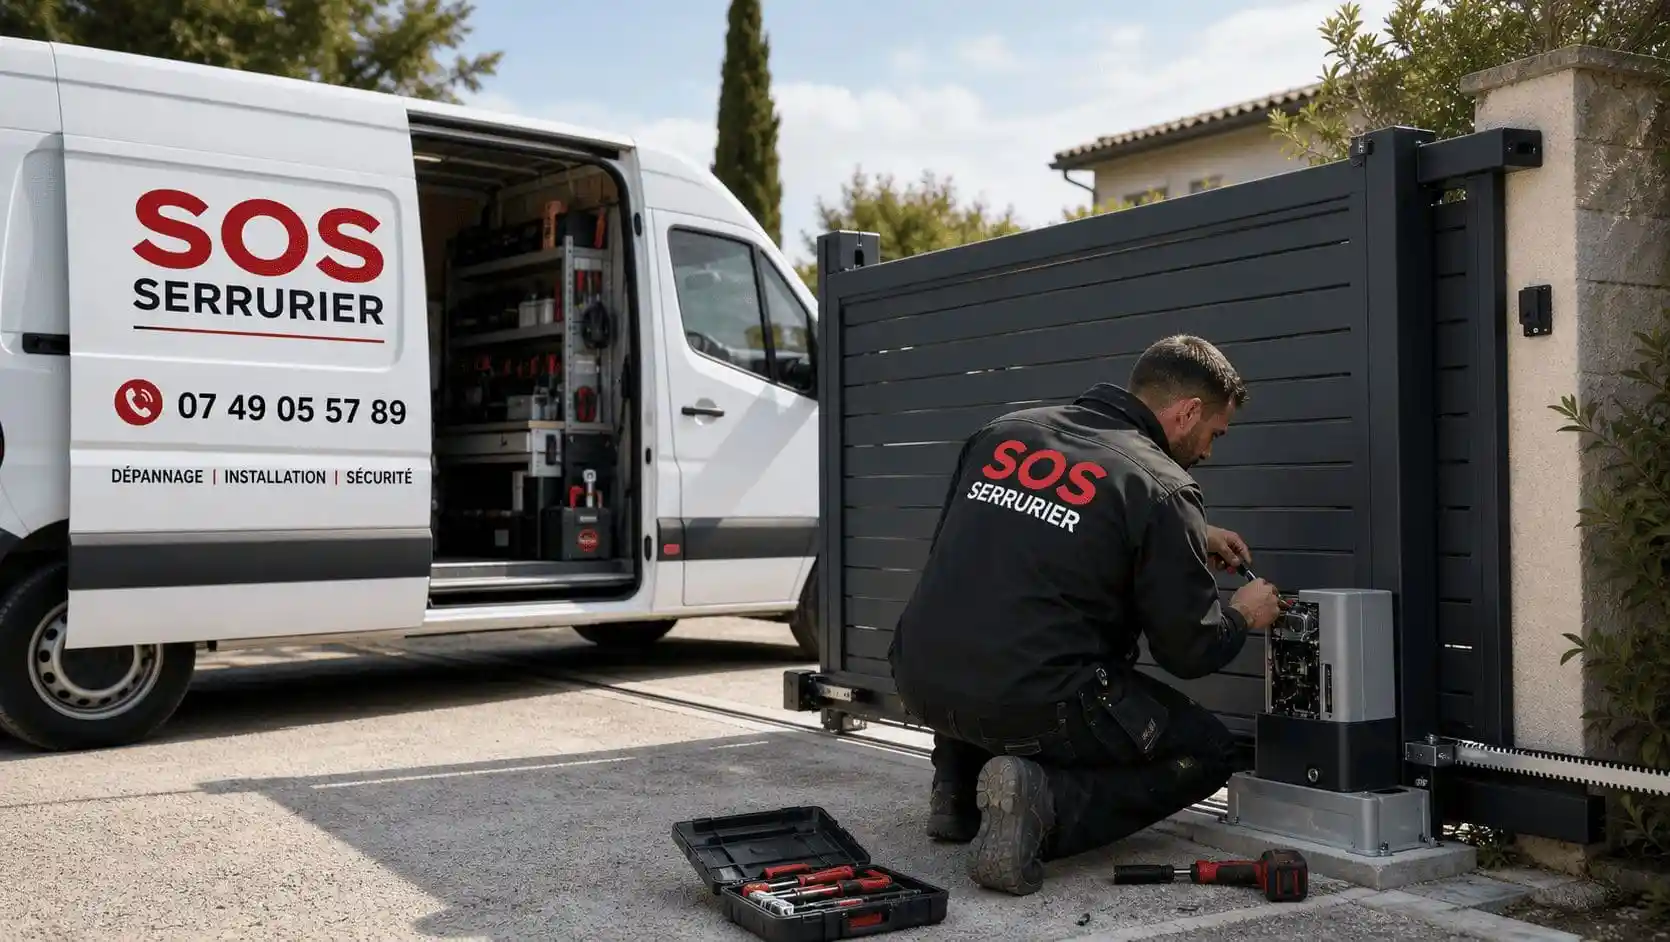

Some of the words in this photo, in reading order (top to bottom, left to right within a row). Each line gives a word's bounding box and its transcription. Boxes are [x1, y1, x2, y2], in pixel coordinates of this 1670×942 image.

[132, 189, 384, 283] SOS
[133, 278, 384, 325] SERRURIER
[178, 392, 217, 419] 07
[227, 395, 266, 421] 49
[277, 396, 315, 422] 05
[325, 398, 361, 424] 57
[370, 399, 407, 425] 89
[111, 466, 204, 484] DÉPANNAGE
[224, 469, 326, 485] INSTALLATION
[346, 468, 413, 485] SÉCURITÉ
[982, 440, 1108, 505] SOS
[966, 481, 1081, 533] SERRURIER
